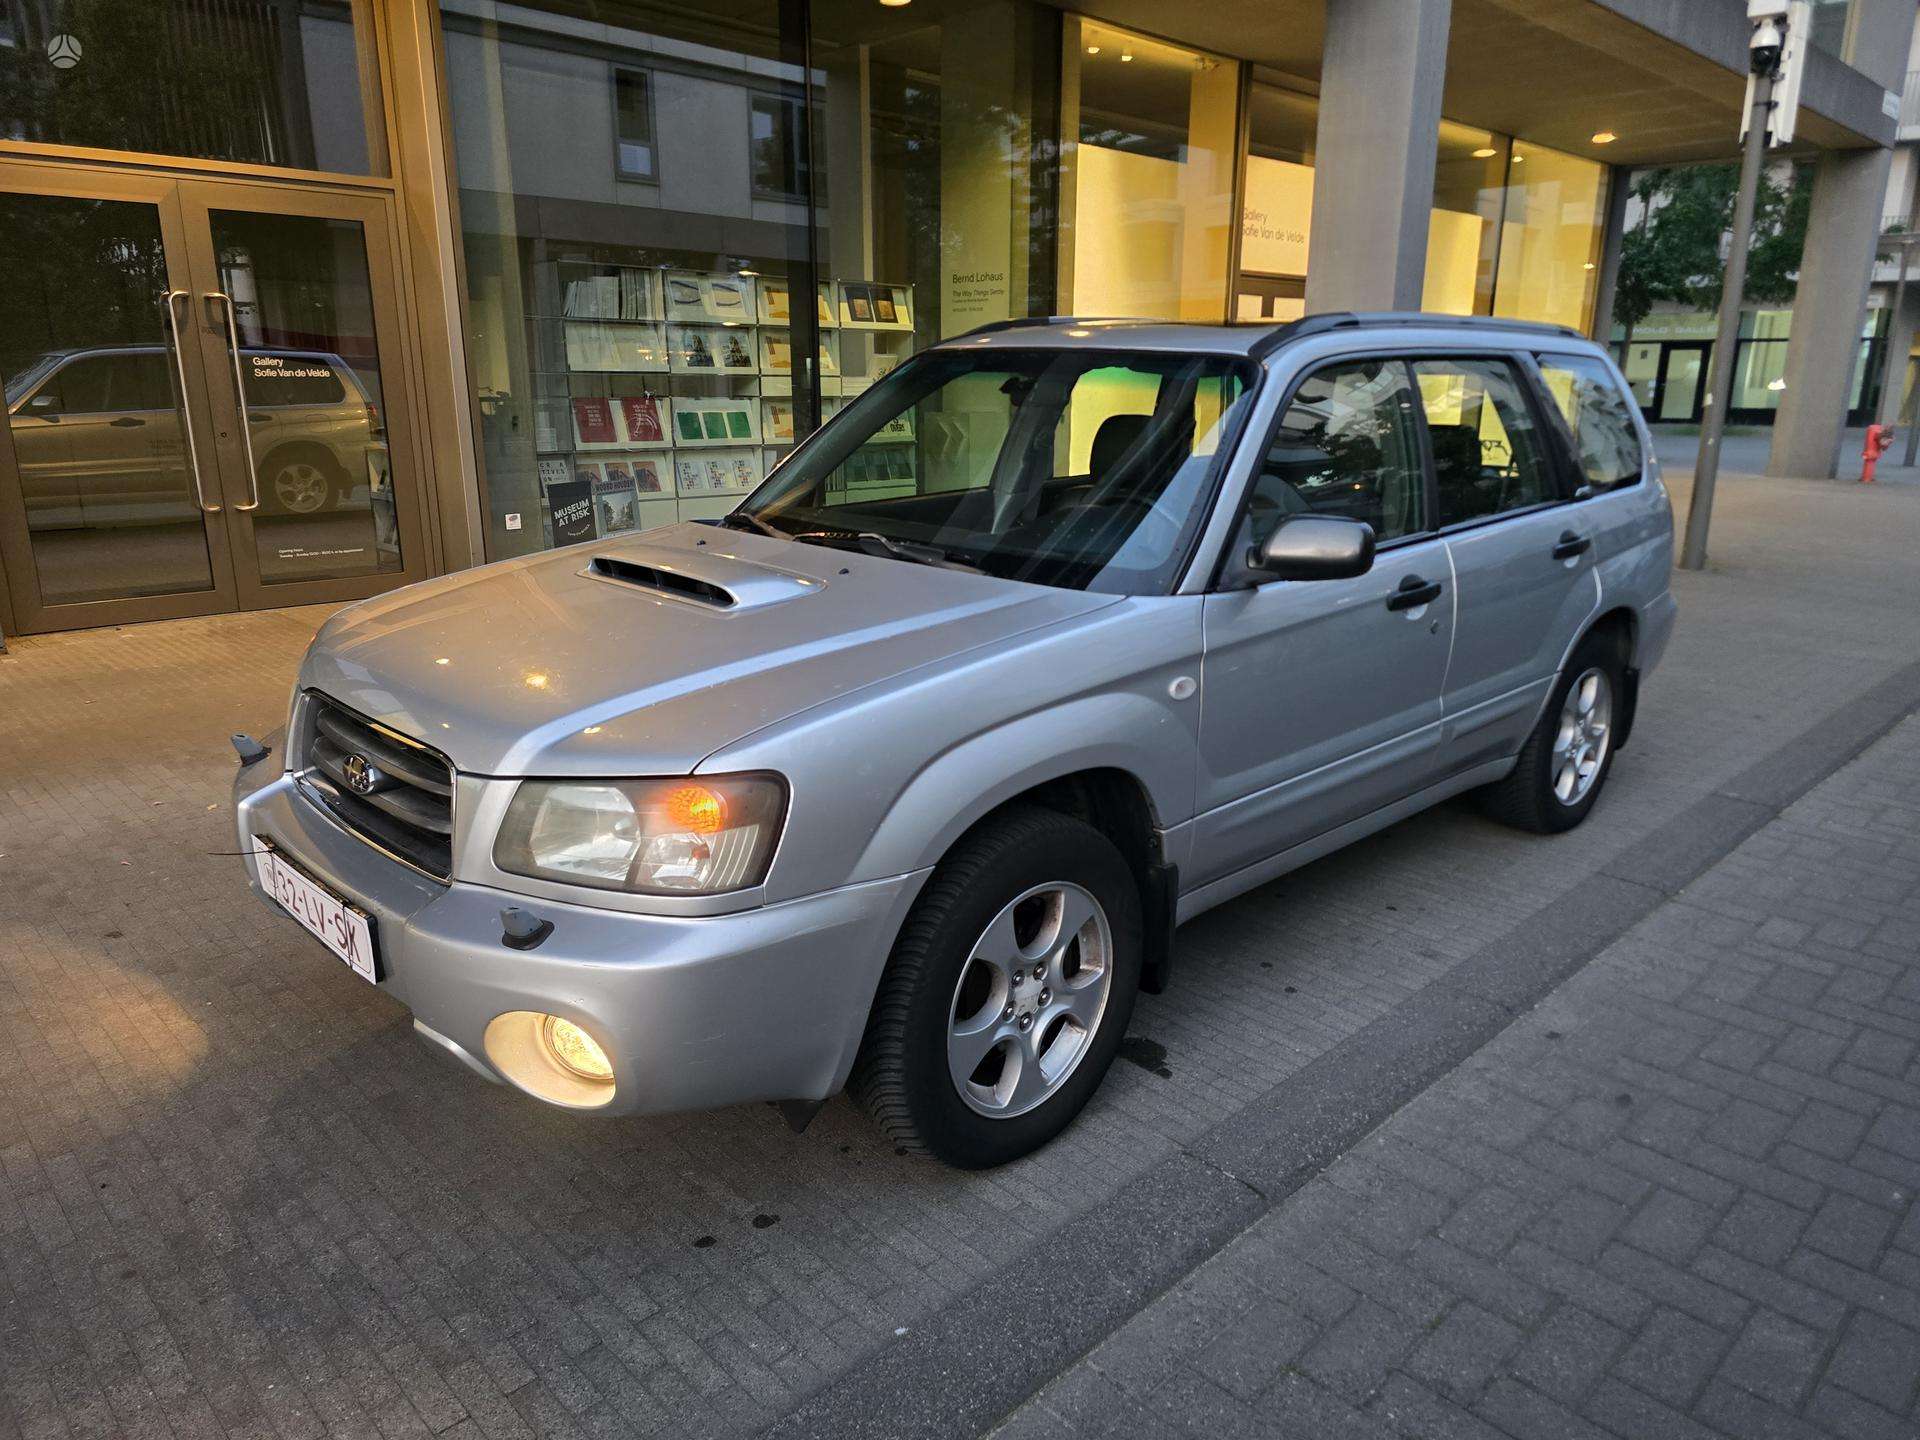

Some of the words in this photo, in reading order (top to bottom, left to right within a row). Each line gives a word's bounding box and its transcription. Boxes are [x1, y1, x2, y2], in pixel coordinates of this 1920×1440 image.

[1260, 227, 1274, 239] Van
[1275, 228, 1285, 240] de
[952, 273, 975, 284] Bernd
[976, 272, 1004, 282] Lohaus
[252, 357, 284, 367] Gallery
[254, 368, 277, 377] Sofie
[277, 368, 294, 377] Van
[295, 368, 306, 377] de
[306, 368, 330, 377] Velde
[554, 498, 590, 519] MUSEUM
[558, 516, 570, 527] AT
[570, 507, 590, 522] RISK
[277, 870, 361, 962] 32-LV-SK
